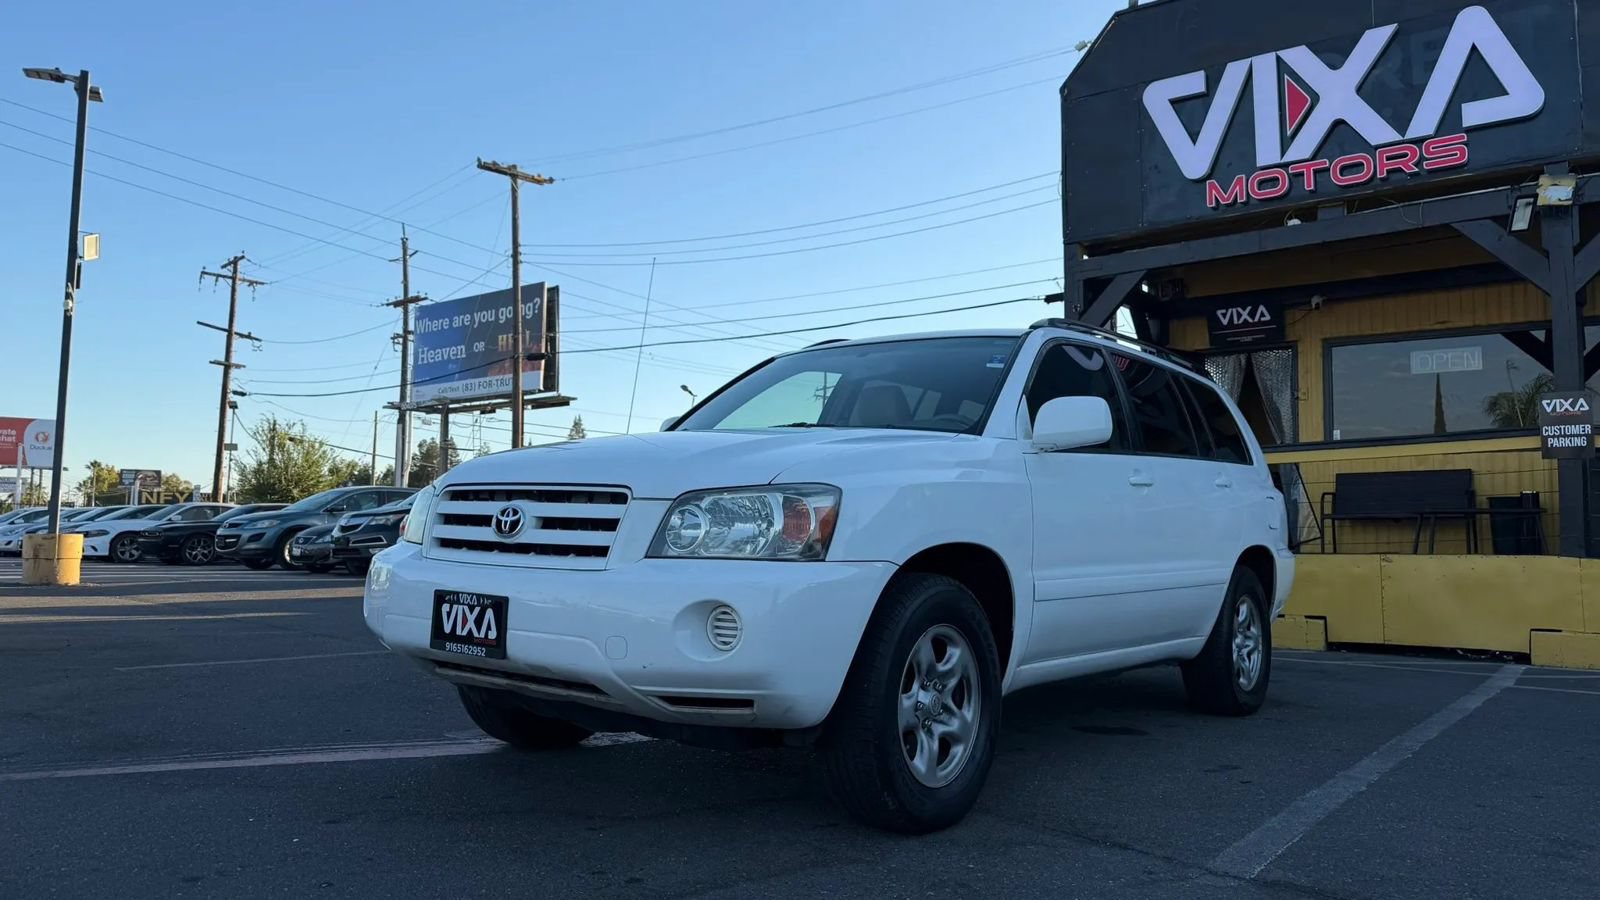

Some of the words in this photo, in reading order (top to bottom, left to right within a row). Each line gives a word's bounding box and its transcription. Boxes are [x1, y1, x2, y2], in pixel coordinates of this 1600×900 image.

[1142, 5, 1545, 180] VIXA
[1206, 133, 1468, 208] MOTORS
[416, 317, 450, 334] Where
[452, 313, 471, 328] are
[474, 309, 496, 328] you
[498, 297, 541, 324] gong?
[1216, 304, 1271, 326] VIXA
[418, 345, 466, 364] Heaven
[474, 342, 485, 352] OR
[498, 329, 533, 352] HEL
[1419, 351, 1478, 370] OPEN
[462, 381, 476, 393] (83)
[477, 377, 513, 390] FOR-TRU
[1541, 397, 1590, 413] VIXA
[1542, 424, 1592, 436] CUSTOMER
[1547, 436, 1587, 448] PARKING
[459, 593, 478, 605] VIXA
[441, 603, 497, 640] VIXA
[445, 642, 486, 657] 9165162952
